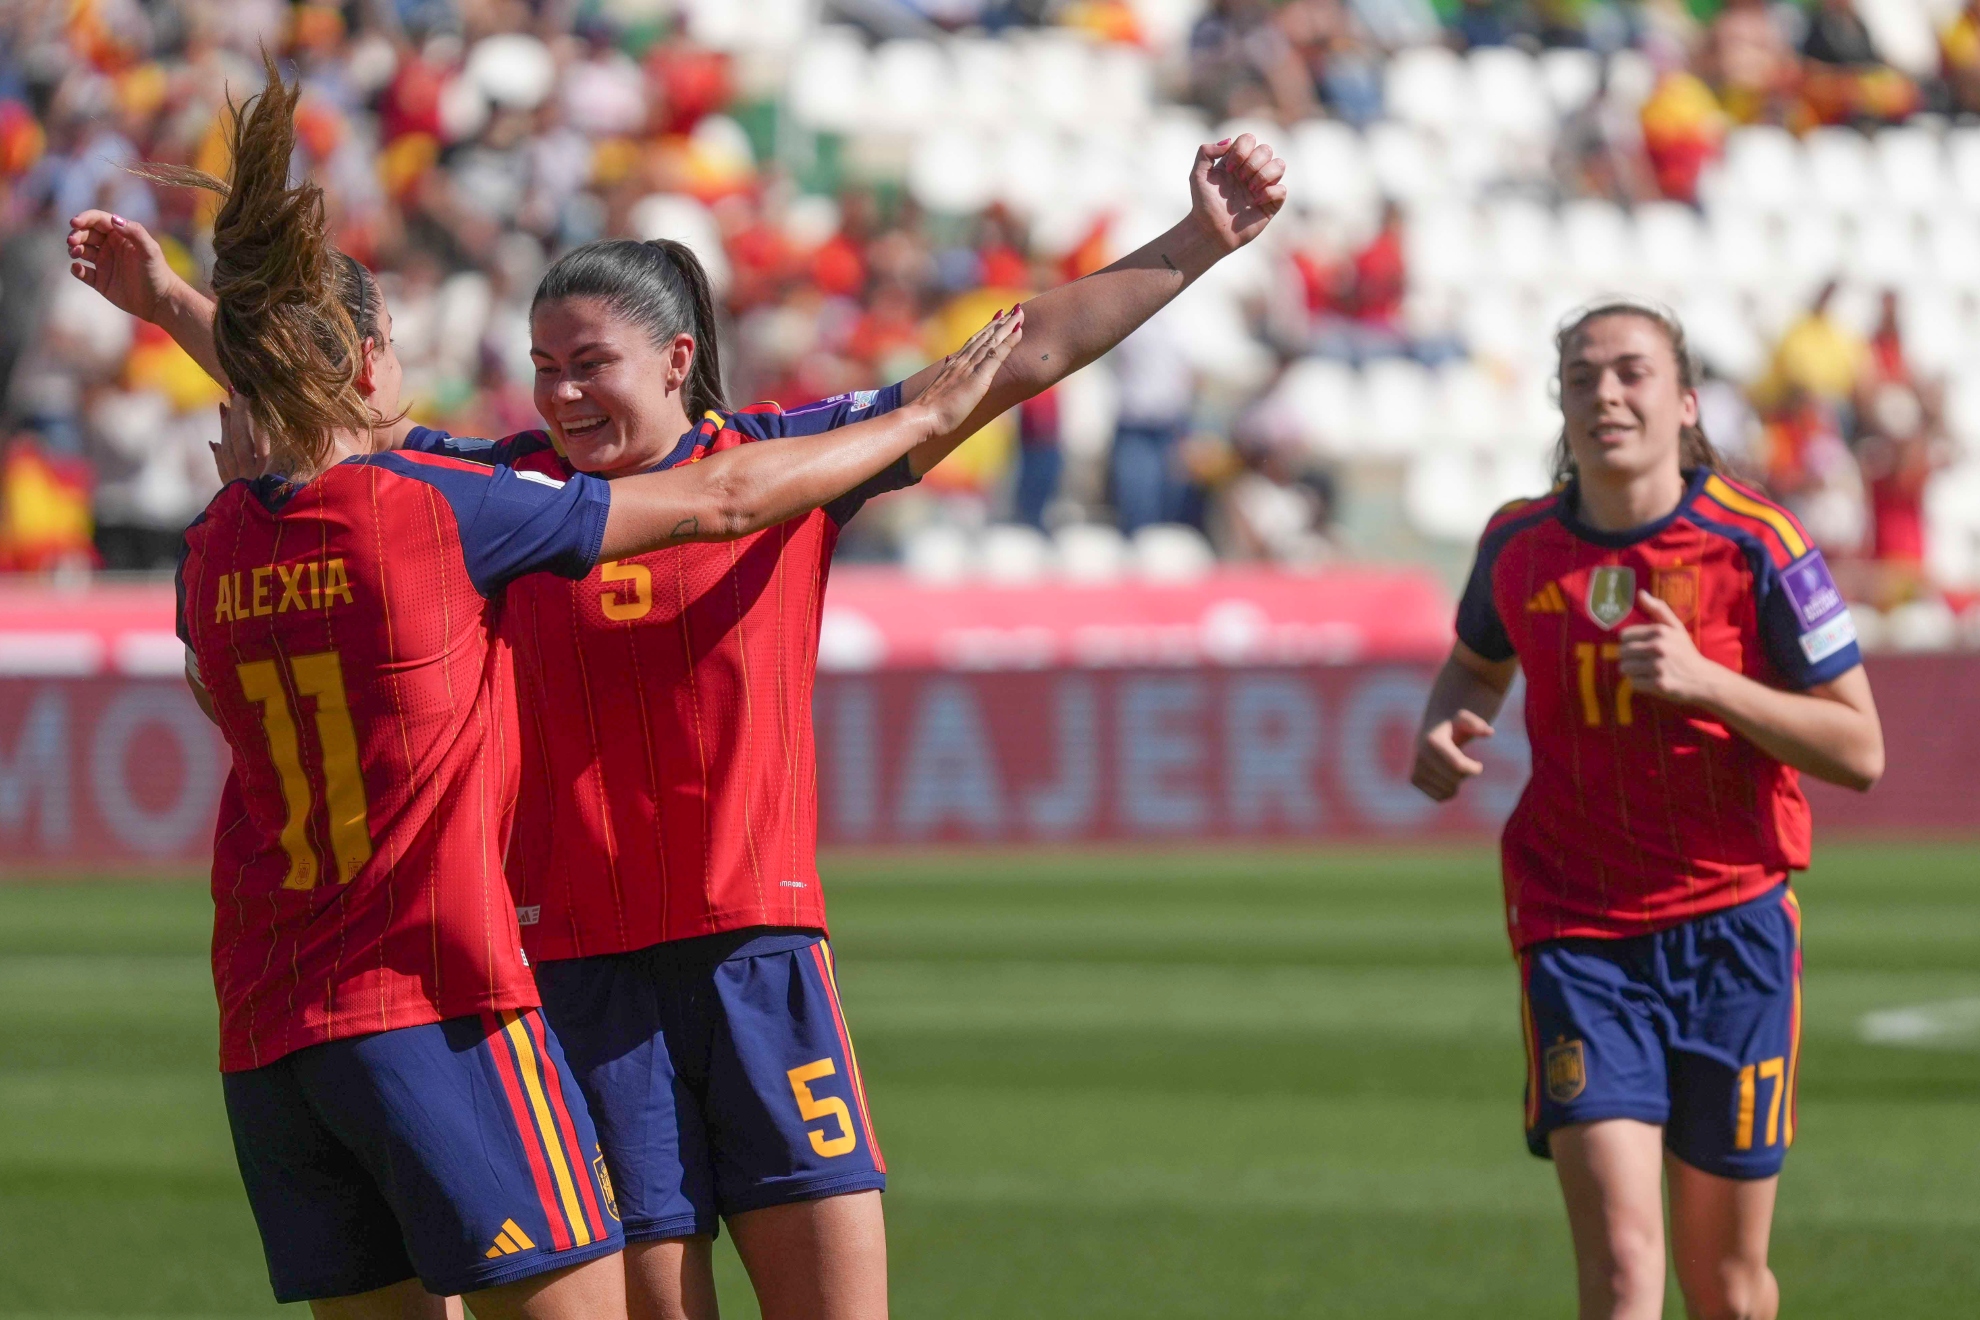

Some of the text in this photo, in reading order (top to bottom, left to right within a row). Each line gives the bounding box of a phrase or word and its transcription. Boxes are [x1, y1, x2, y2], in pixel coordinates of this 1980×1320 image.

[216, 558, 354, 623] ALEXIA
[601, 561, 652, 620] 5
[1576, 642, 1635, 726] 17
[236, 651, 372, 889] 11
[786, 1057, 857, 1158] 5
[1735, 1056, 1784, 1149] 17
